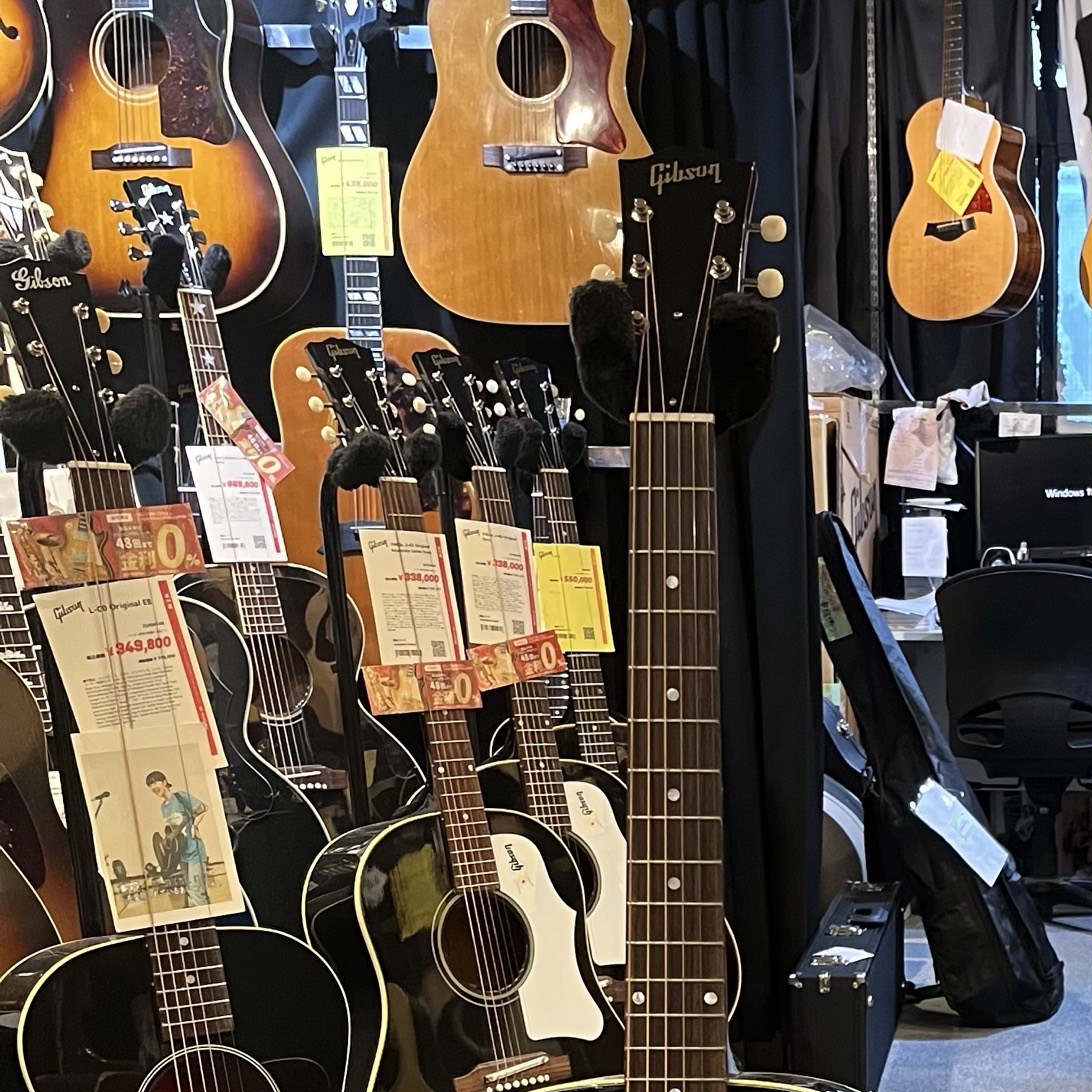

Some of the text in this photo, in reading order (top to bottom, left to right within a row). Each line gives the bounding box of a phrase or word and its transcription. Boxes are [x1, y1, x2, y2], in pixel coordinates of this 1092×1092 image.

[650, 161, 722, 196] Gibson
[11, 266, 72, 291] Gibson
[325, 343, 361, 359] Gibson
[431, 354, 463, 367] Gibson
[1044, 488, 1084, 499] Windows
[53, 601, 87, 624] Gibson
[109, 600, 142, 613] Original
[576, 790, 594, 816] Gibson
[504, 843, 524, 872] Gibson
